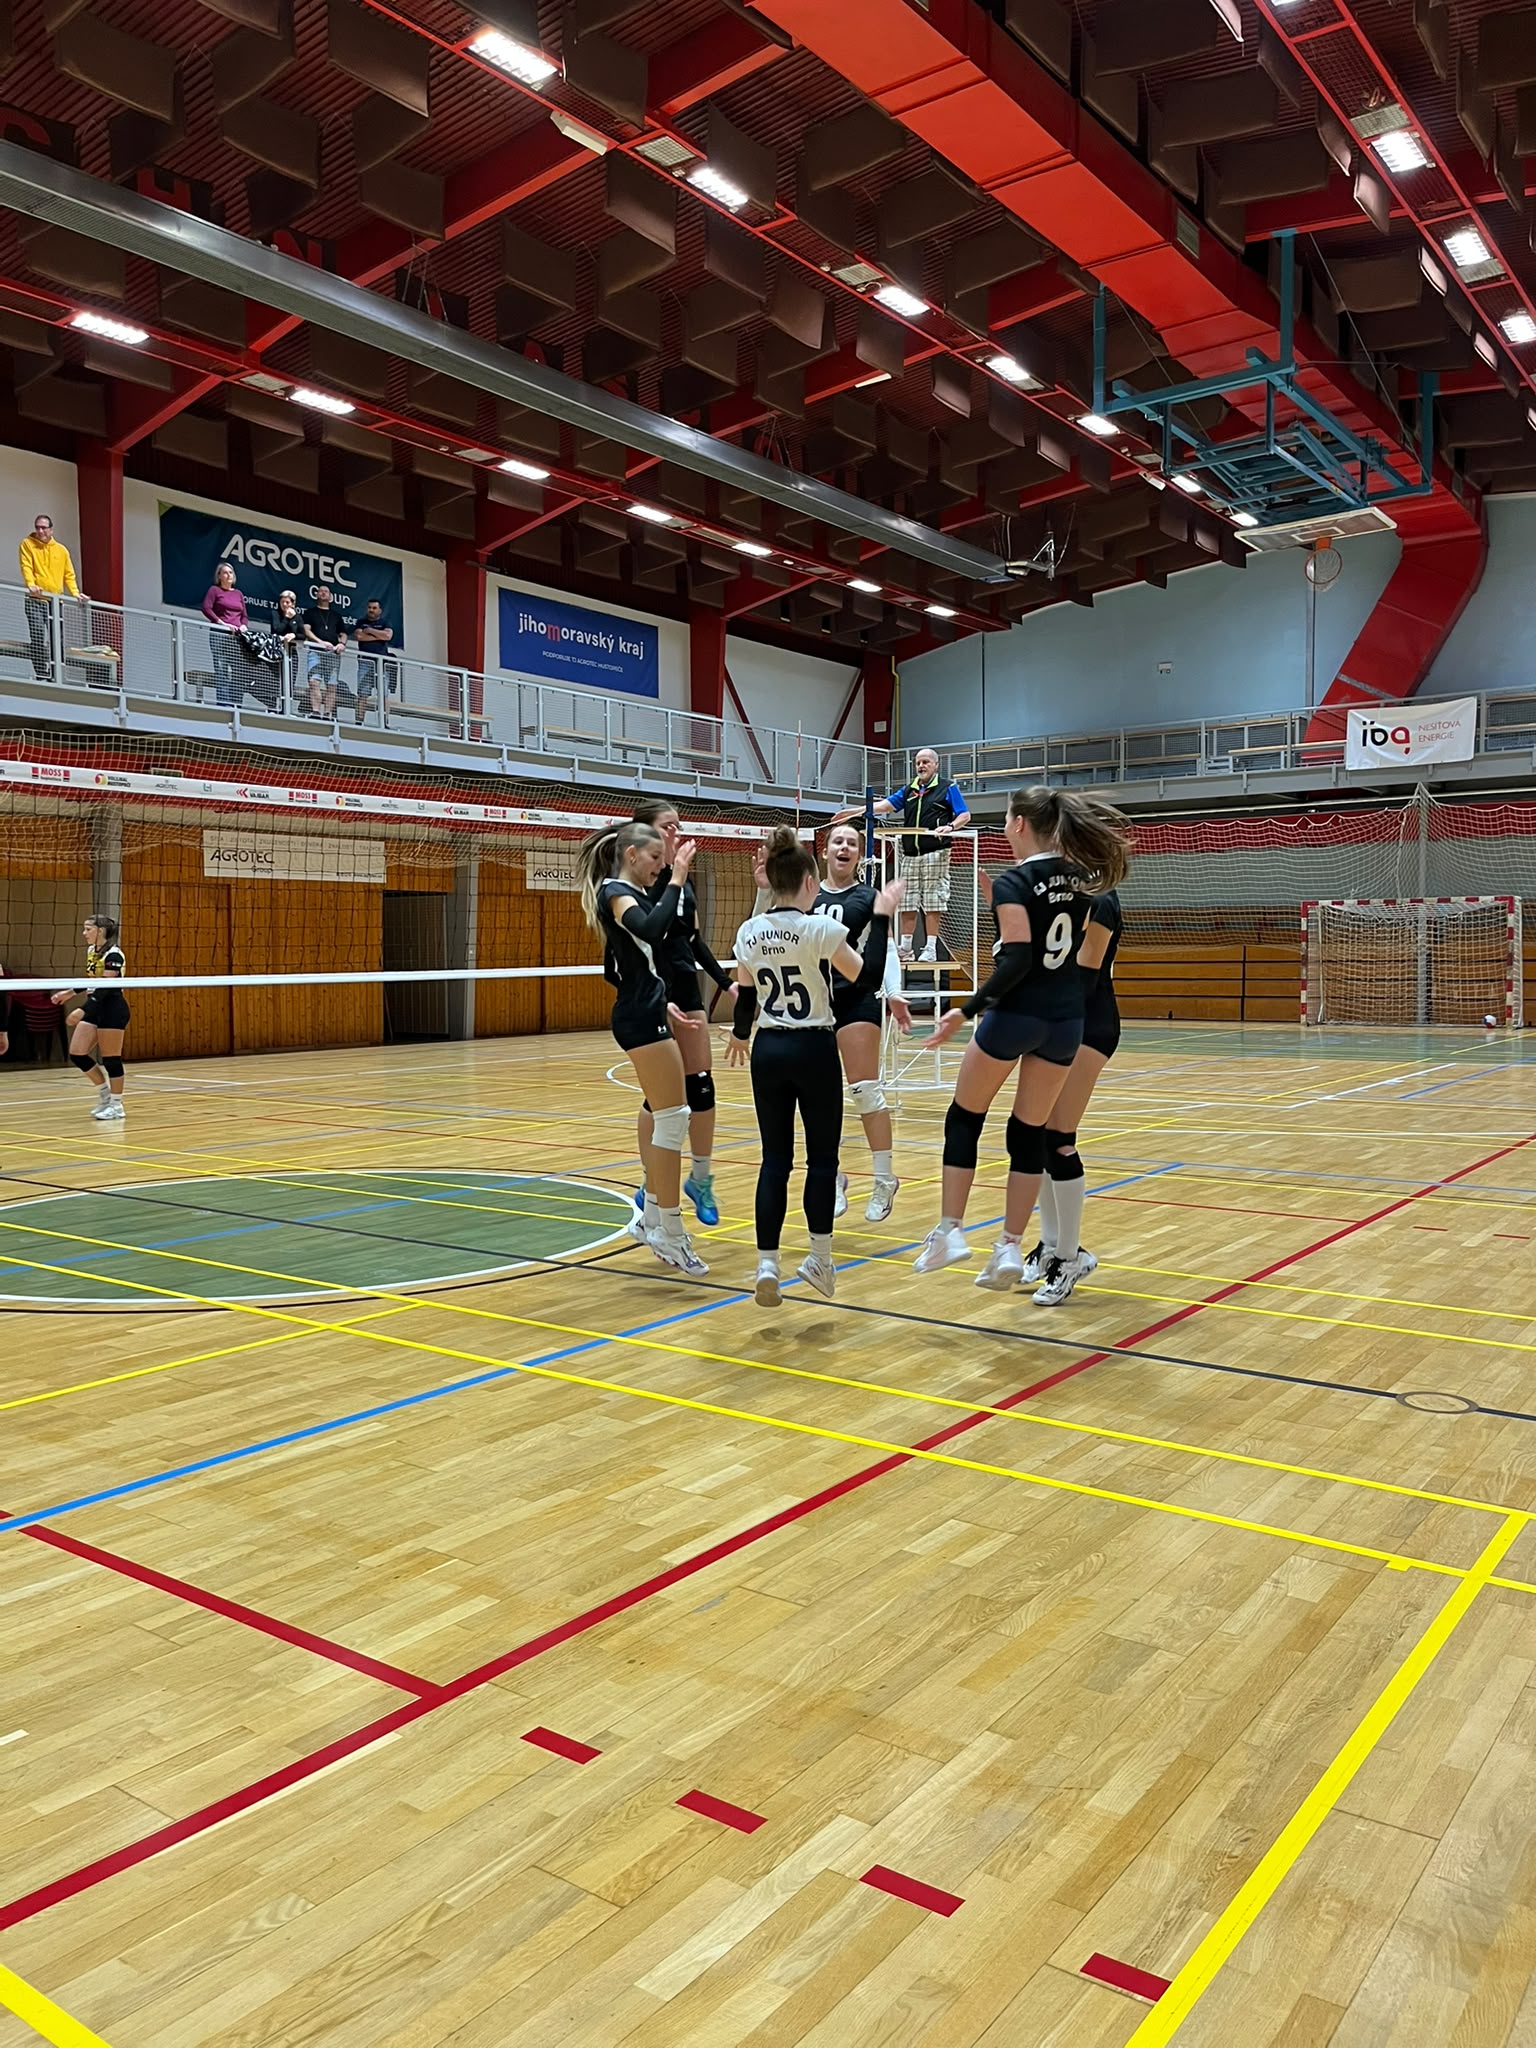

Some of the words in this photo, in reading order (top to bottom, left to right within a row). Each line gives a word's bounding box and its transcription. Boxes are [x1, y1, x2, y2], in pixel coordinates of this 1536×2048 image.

[220, 533, 357, 588] AGROTEC
[309, 585, 351, 609] Goup
[518, 613, 615, 653] jihomoravský
[618, 636, 644, 660] kraj
[1418, 731, 1455, 743] ENERGIE
[40, 767, 62, 777] MOSS
[210, 849, 275, 864] AGROTEC
[533, 867, 575, 880] AGROTEC
[1048, 892, 1074, 904] Brno
[746, 935, 758, 949] TJ
[760, 930, 800, 945] JUNIOR
[1043, 912, 1072, 970] 9
[762, 945, 785, 956] Brno
[757, 965, 811, 1020] 25
